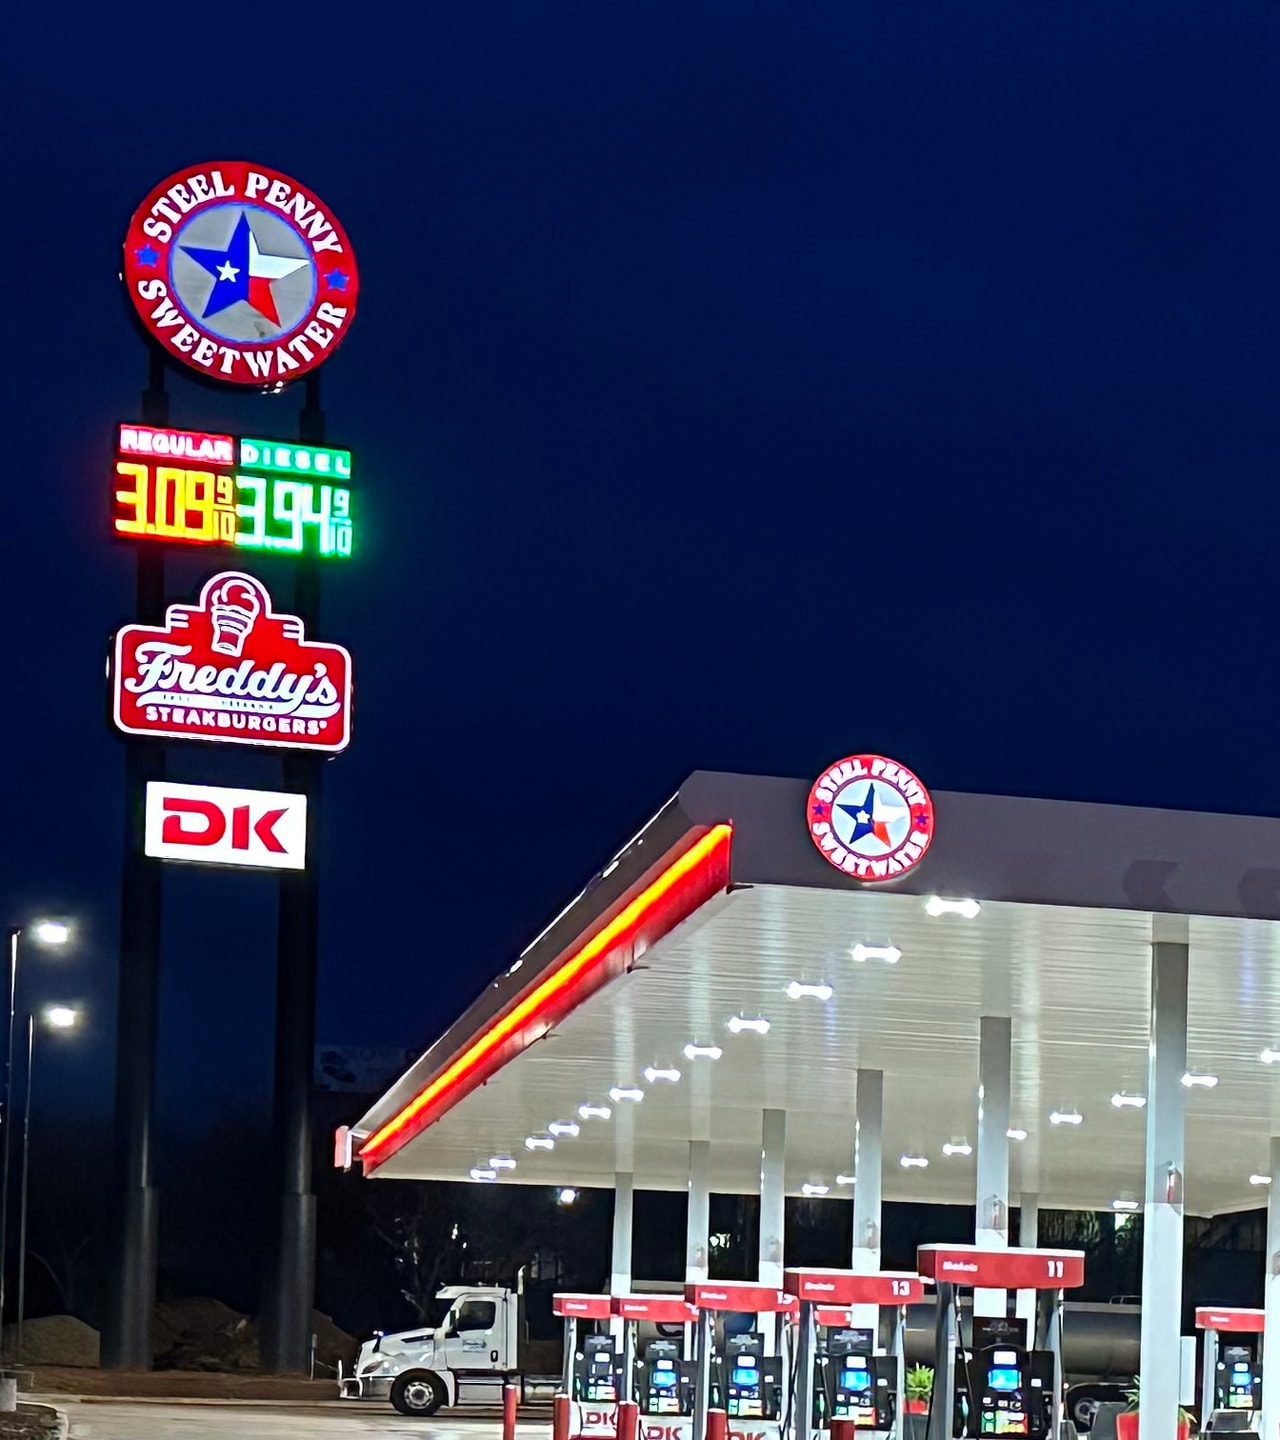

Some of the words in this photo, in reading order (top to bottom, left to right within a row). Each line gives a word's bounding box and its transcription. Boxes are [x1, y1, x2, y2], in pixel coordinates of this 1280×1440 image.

[143, 171, 235, 243] STEEL
[244, 172, 343, 254] PENNY
[138, 279, 347, 378] SWEETWATER
[120, 430, 232, 460] REGULAR
[241, 443, 350, 476] DIESEL
[115, 462, 215, 541] 3.09
[235, 475, 331, 554] 3.94
[124, 641, 341, 716] Freddy's
[815, 759, 867, 803] STEEL
[871, 759, 926, 804] PENNY
[162, 797, 289, 854] DK
[813, 822, 928, 877] SWEETWATER
[891, 1281, 911, 1296] 13
[1047, 1261, 1064, 1278] 11
